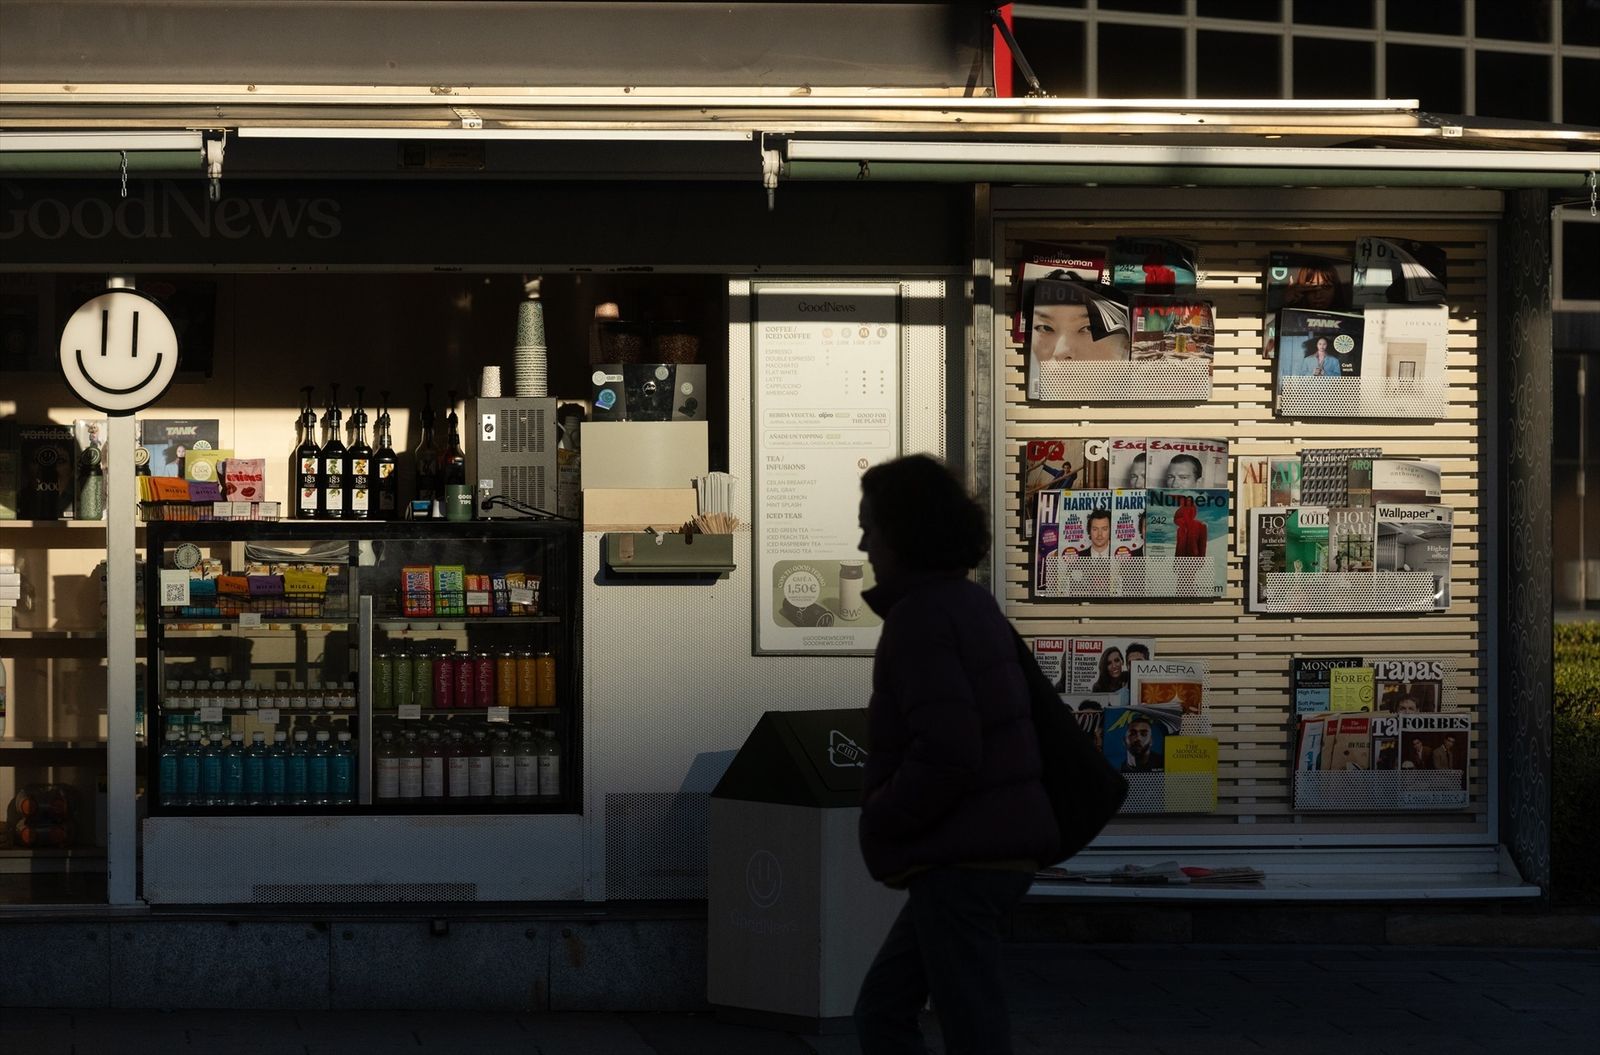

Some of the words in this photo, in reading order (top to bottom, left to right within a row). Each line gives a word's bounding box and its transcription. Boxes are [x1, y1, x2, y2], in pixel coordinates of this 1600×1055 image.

[0, 179, 343, 241] GoodNews
[1032, 254, 1094, 268] gentlewoman
[798, 301, 857, 313] GoodNews
[1306, 318, 1343, 330] TANK
[165, 425, 200, 436] TANK
[1149, 440, 1228, 456] Esquire
[766, 463, 806, 471] INFUSIONS
[1064, 497, 1099, 511] HARRY
[1150, 490, 1227, 508] Numéro
[1150, 516, 1167, 525] 242
[1136, 664, 1196, 675] MANERA
[1301, 661, 1357, 671] MONOCLE
[1374, 659, 1443, 684] Tapas
[1402, 717, 1469, 730] FORBES
